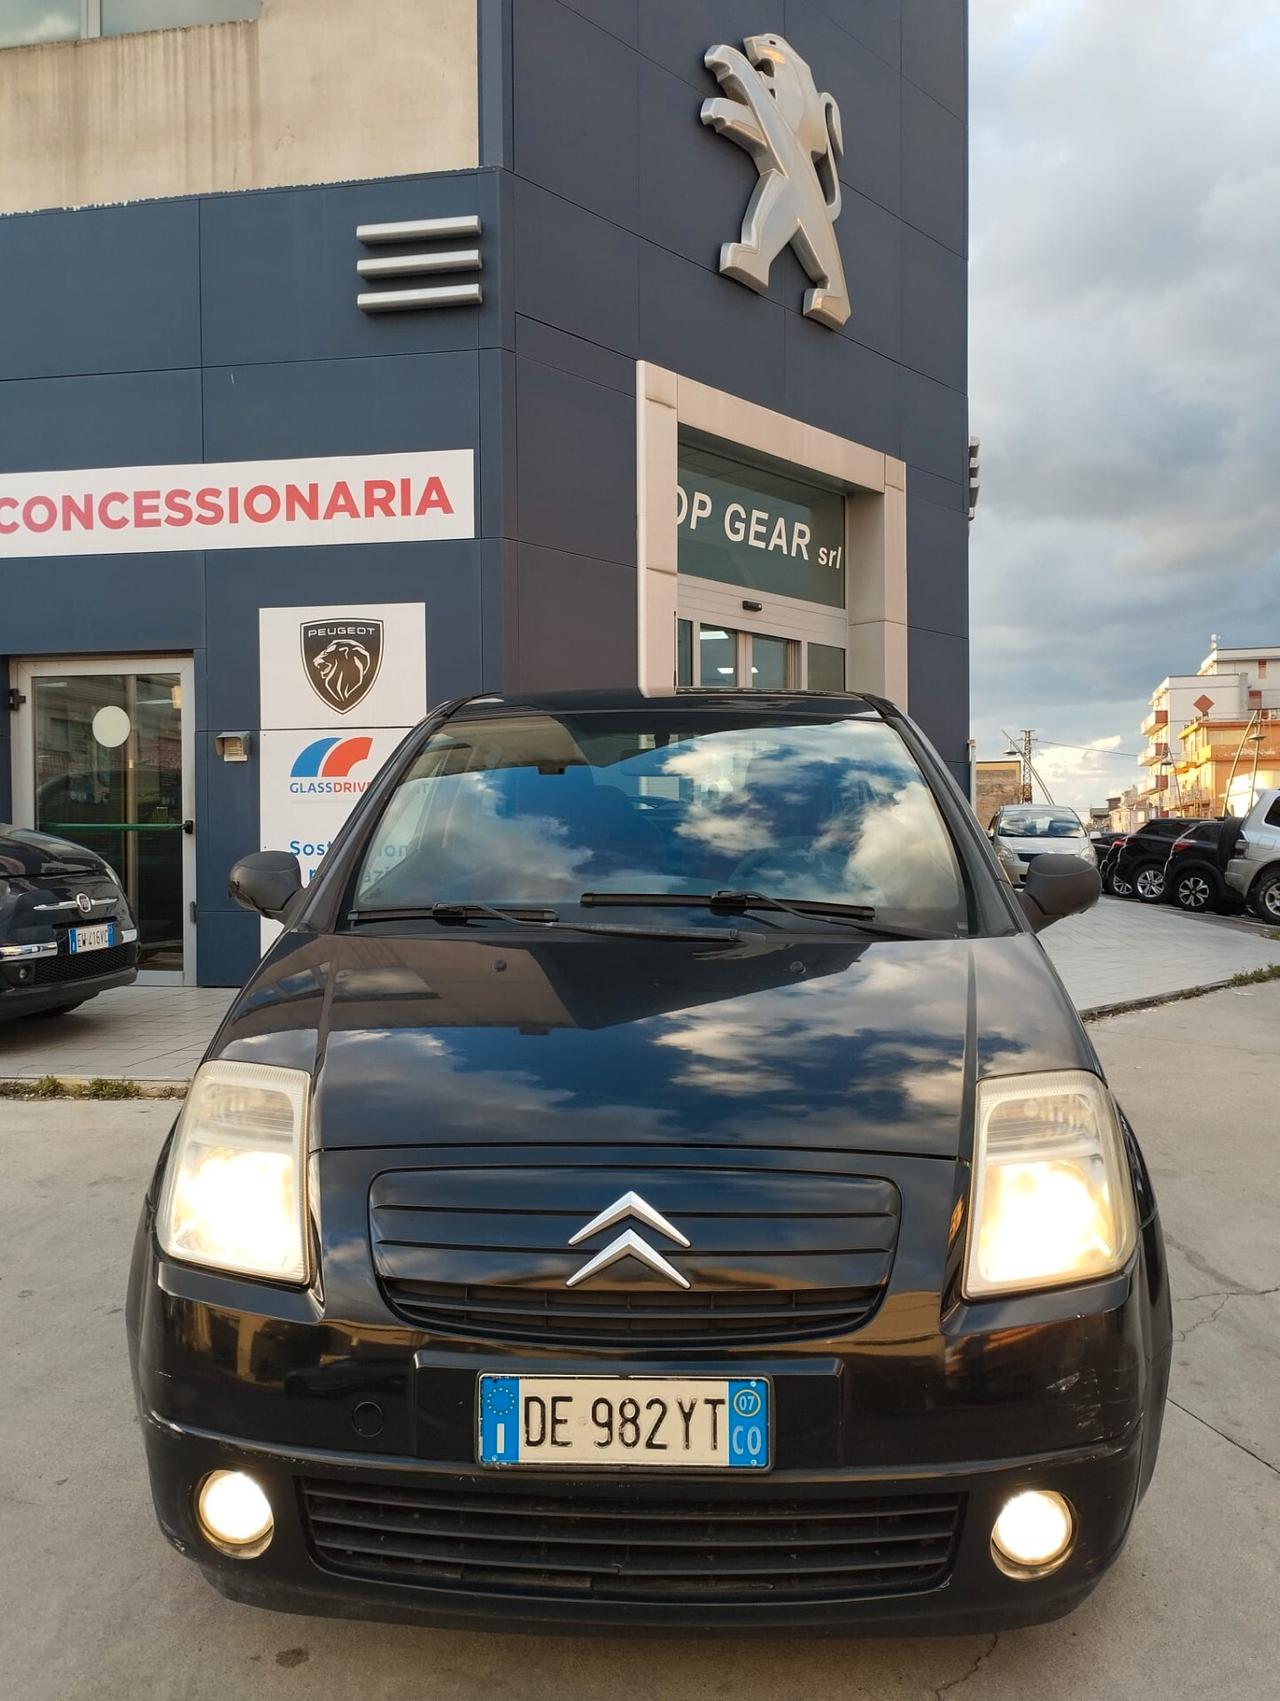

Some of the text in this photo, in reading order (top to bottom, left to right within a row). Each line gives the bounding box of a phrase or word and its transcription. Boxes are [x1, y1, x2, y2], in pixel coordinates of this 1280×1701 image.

[0, 476, 455, 534] CONCESSIONARIA
[724, 503, 811, 561] GEAR
[818, 546, 842, 569] srl
[308, 626, 376, 638] PEUGEOT
[524, 1396, 726, 1450] DE 982YT
[739, 1396, 755, 1411] 07
[732, 1425, 762, 1455] CO
